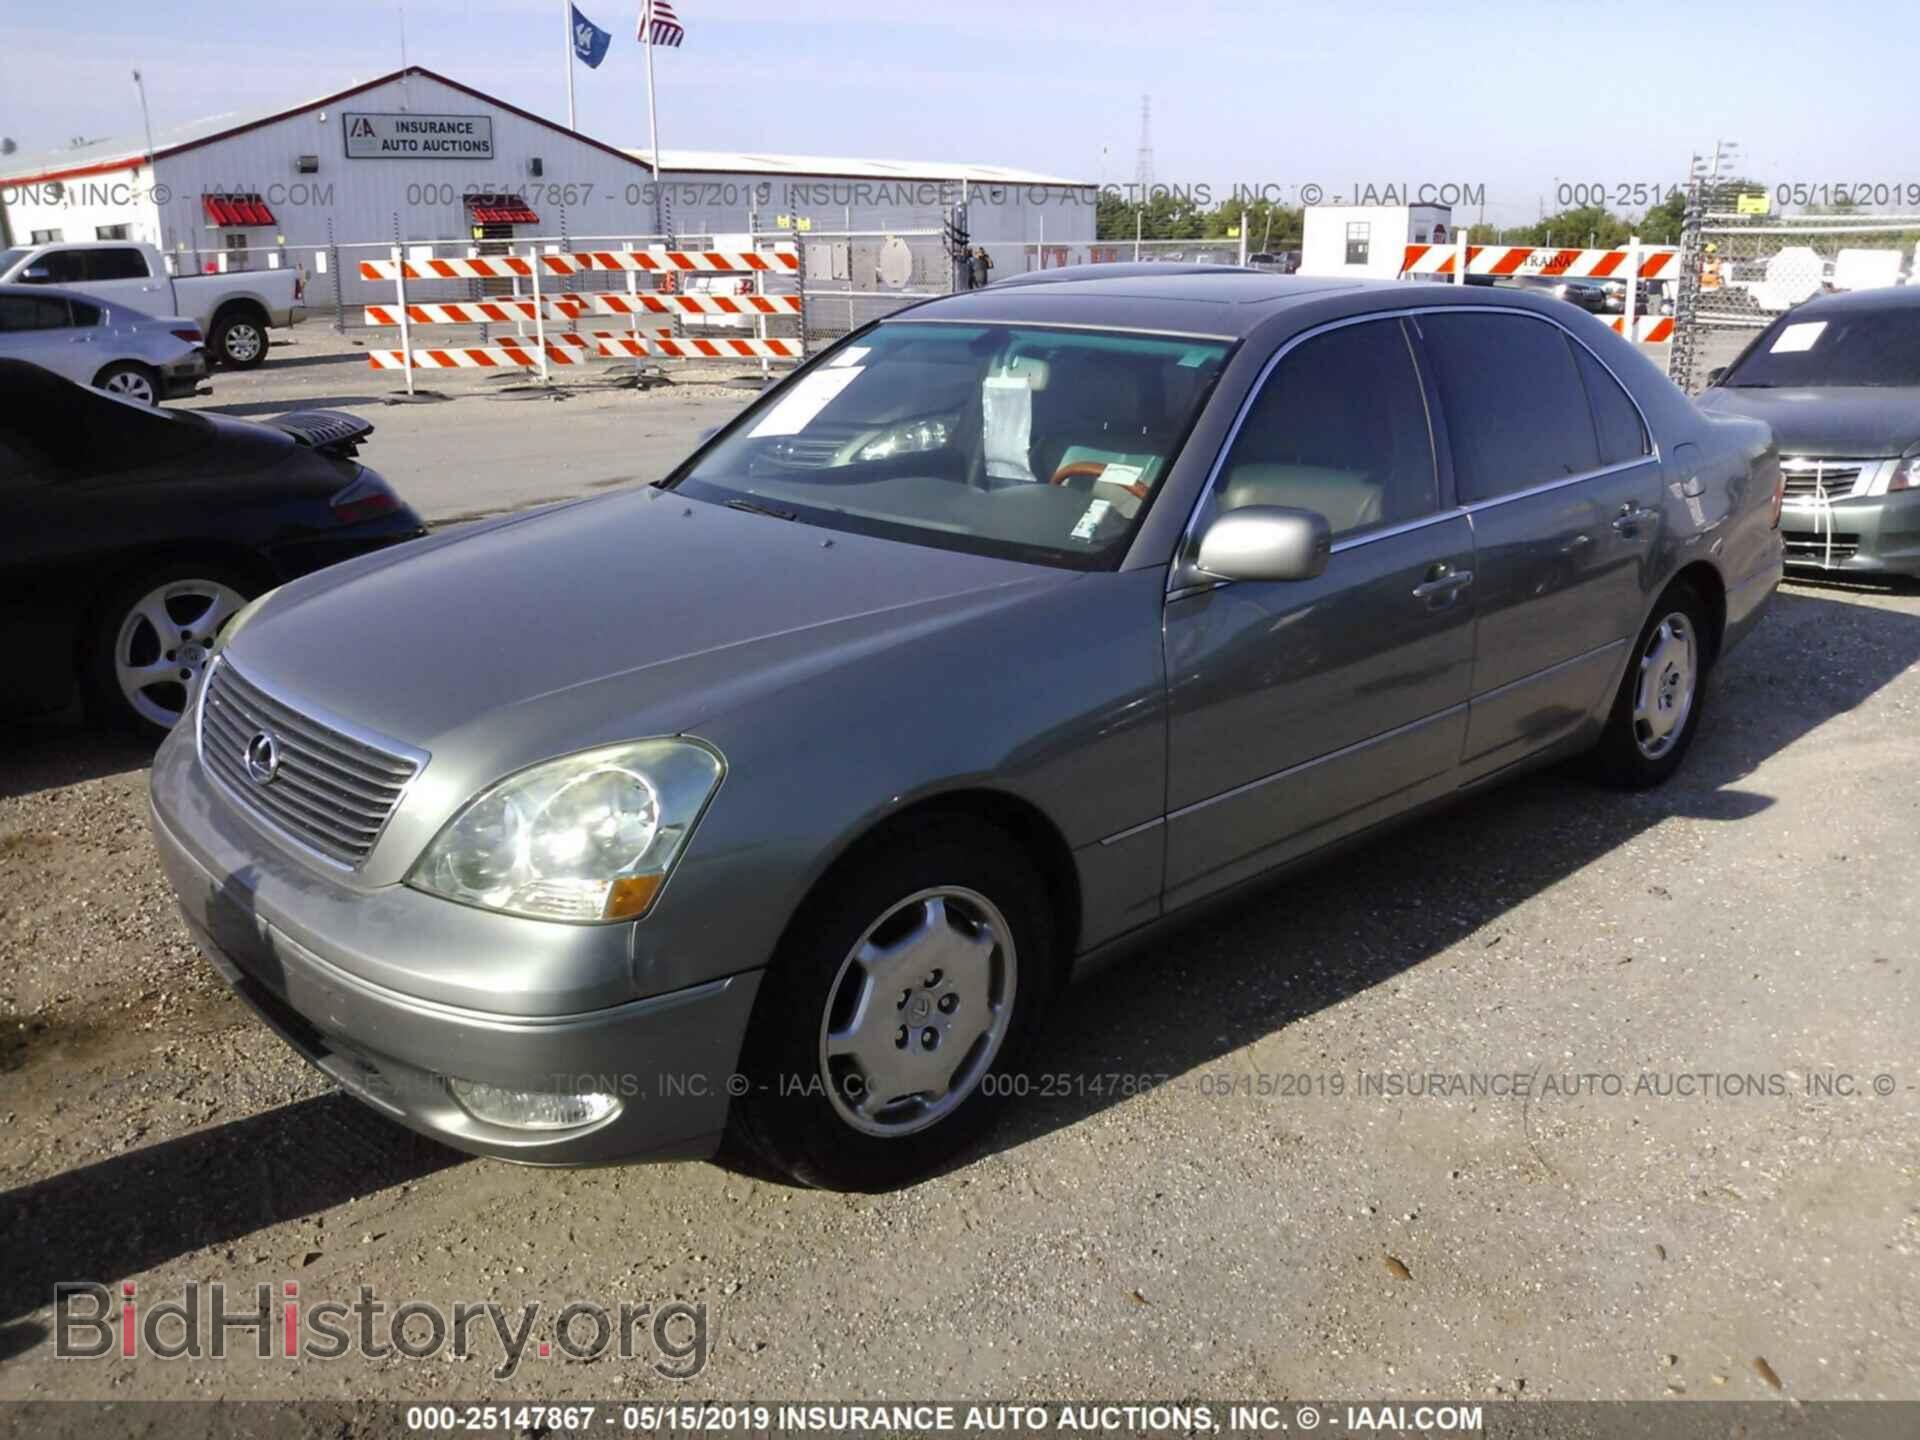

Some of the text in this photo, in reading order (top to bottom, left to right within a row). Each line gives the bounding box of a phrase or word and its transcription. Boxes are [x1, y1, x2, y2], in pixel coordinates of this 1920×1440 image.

[396, 121, 473, 134] INSURANCE
[382, 139, 490, 152] AUTO AUCTIONS
